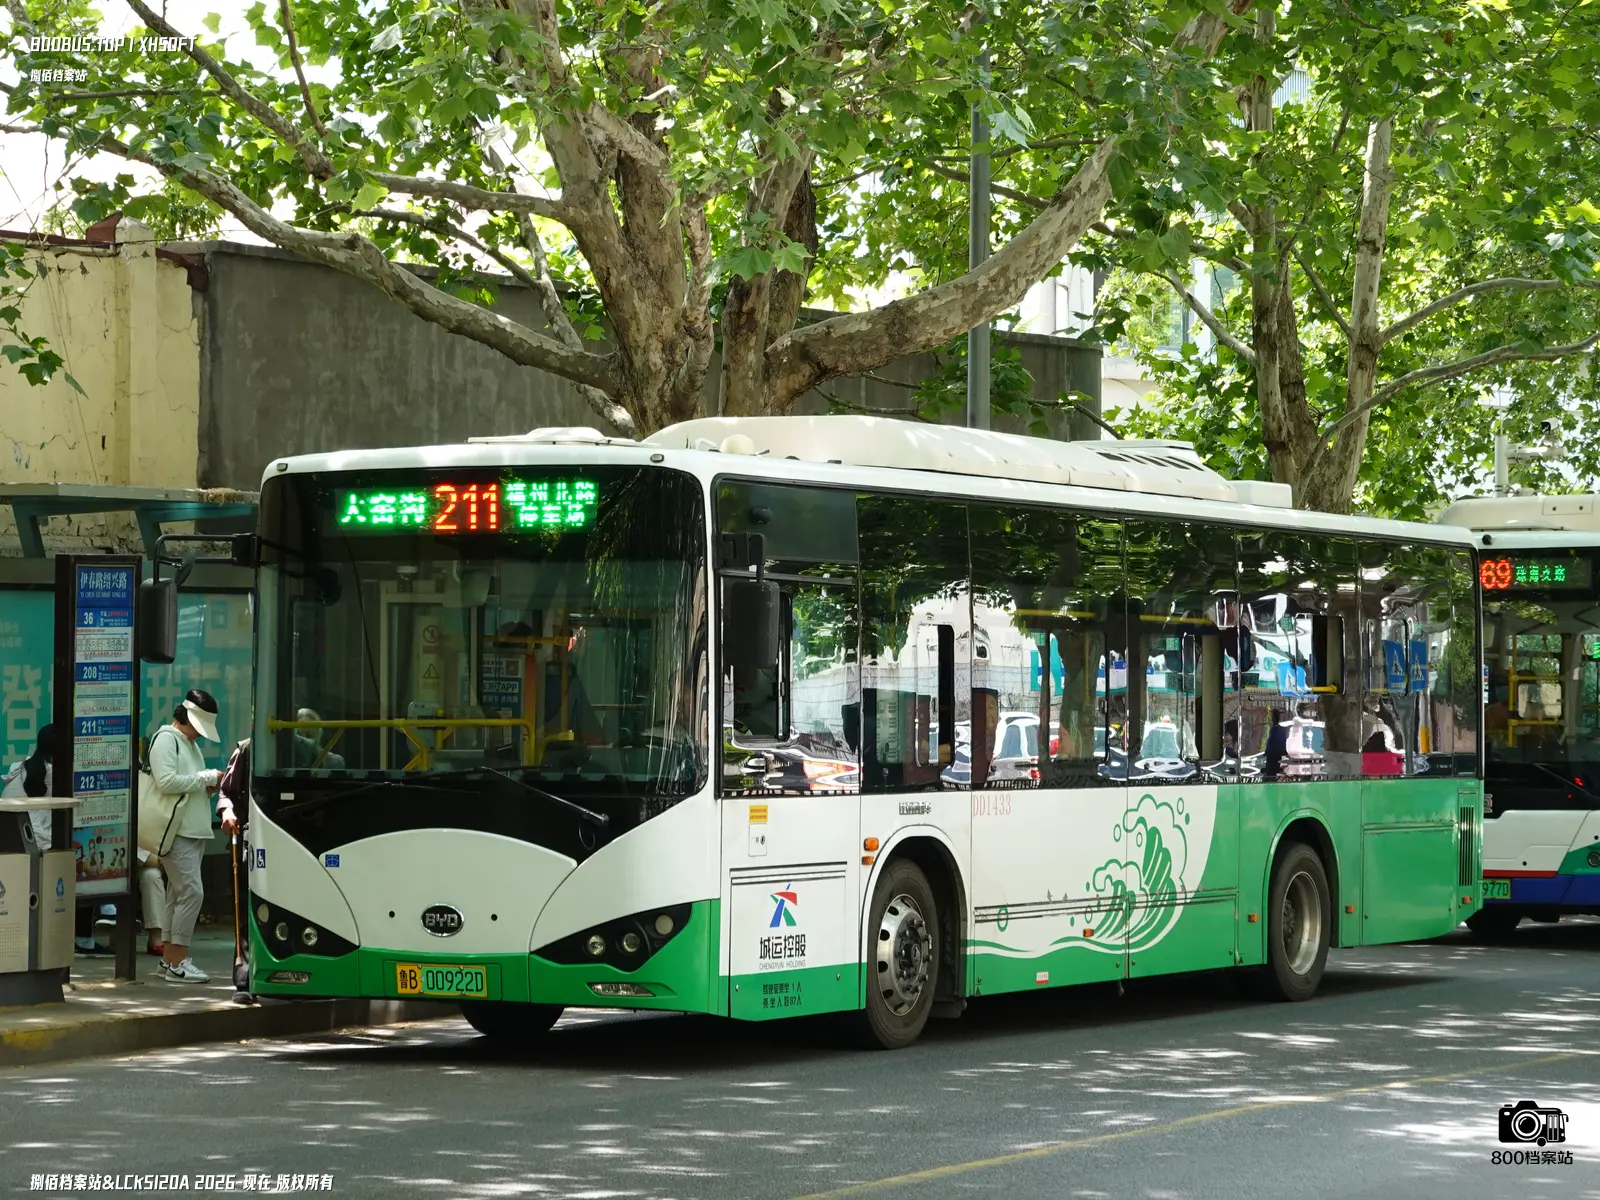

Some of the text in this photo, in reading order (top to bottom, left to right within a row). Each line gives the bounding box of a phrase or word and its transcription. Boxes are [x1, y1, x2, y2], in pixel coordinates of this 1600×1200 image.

[434, 484, 498, 531] 211
[80, 571, 127, 590] 伊春路绍兴路
[83, 611, 94, 625] 36
[83, 666, 98, 680] 208
[81, 720, 96, 734] 211
[80, 775, 95, 789] 212
[973, 793, 1012, 816] DD1433
[425, 912, 459, 928] BYD
[759, 933, 806, 960] 城运控股
[759, 959, 806, 971] CHENGYUN HOLDING
[399, 969, 484, 993] 鲁B 00922D
